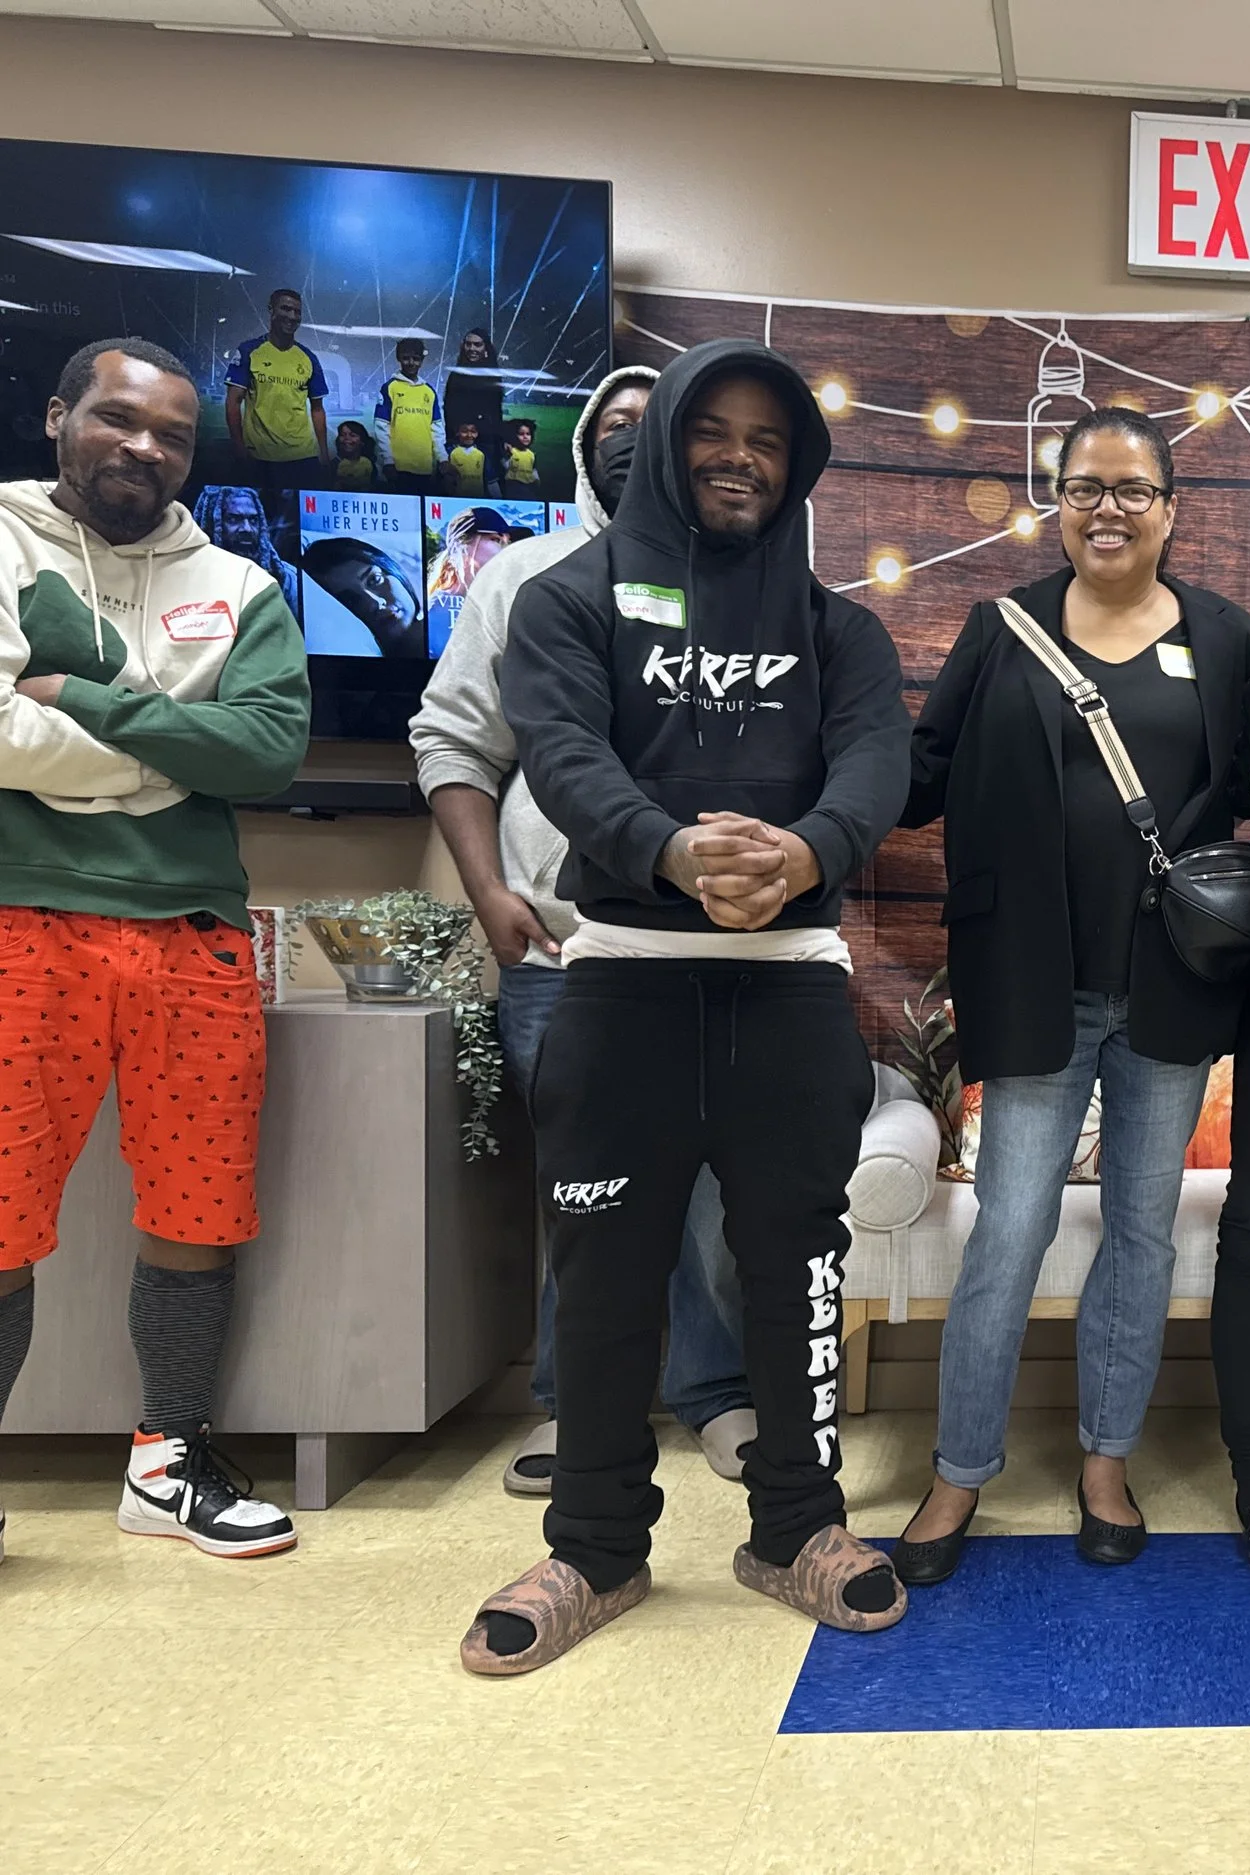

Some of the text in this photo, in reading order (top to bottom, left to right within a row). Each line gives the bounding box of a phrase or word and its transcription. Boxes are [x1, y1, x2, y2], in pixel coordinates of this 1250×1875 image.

[53, 301, 81, 316] this
[305, 496, 316, 513] N
[332, 499, 388, 515] BEHIND
[431, 503, 441, 520] N
[322, 515, 399, 532] HER EYES
[555, 509, 565, 526] N
[617, 585, 650, 596] ello
[642, 645, 799, 698] KERED
[679, 691, 756, 713] COUTU
[553, 1177, 630, 1206] KERED
[569, 1203, 608, 1214] COUTURE
